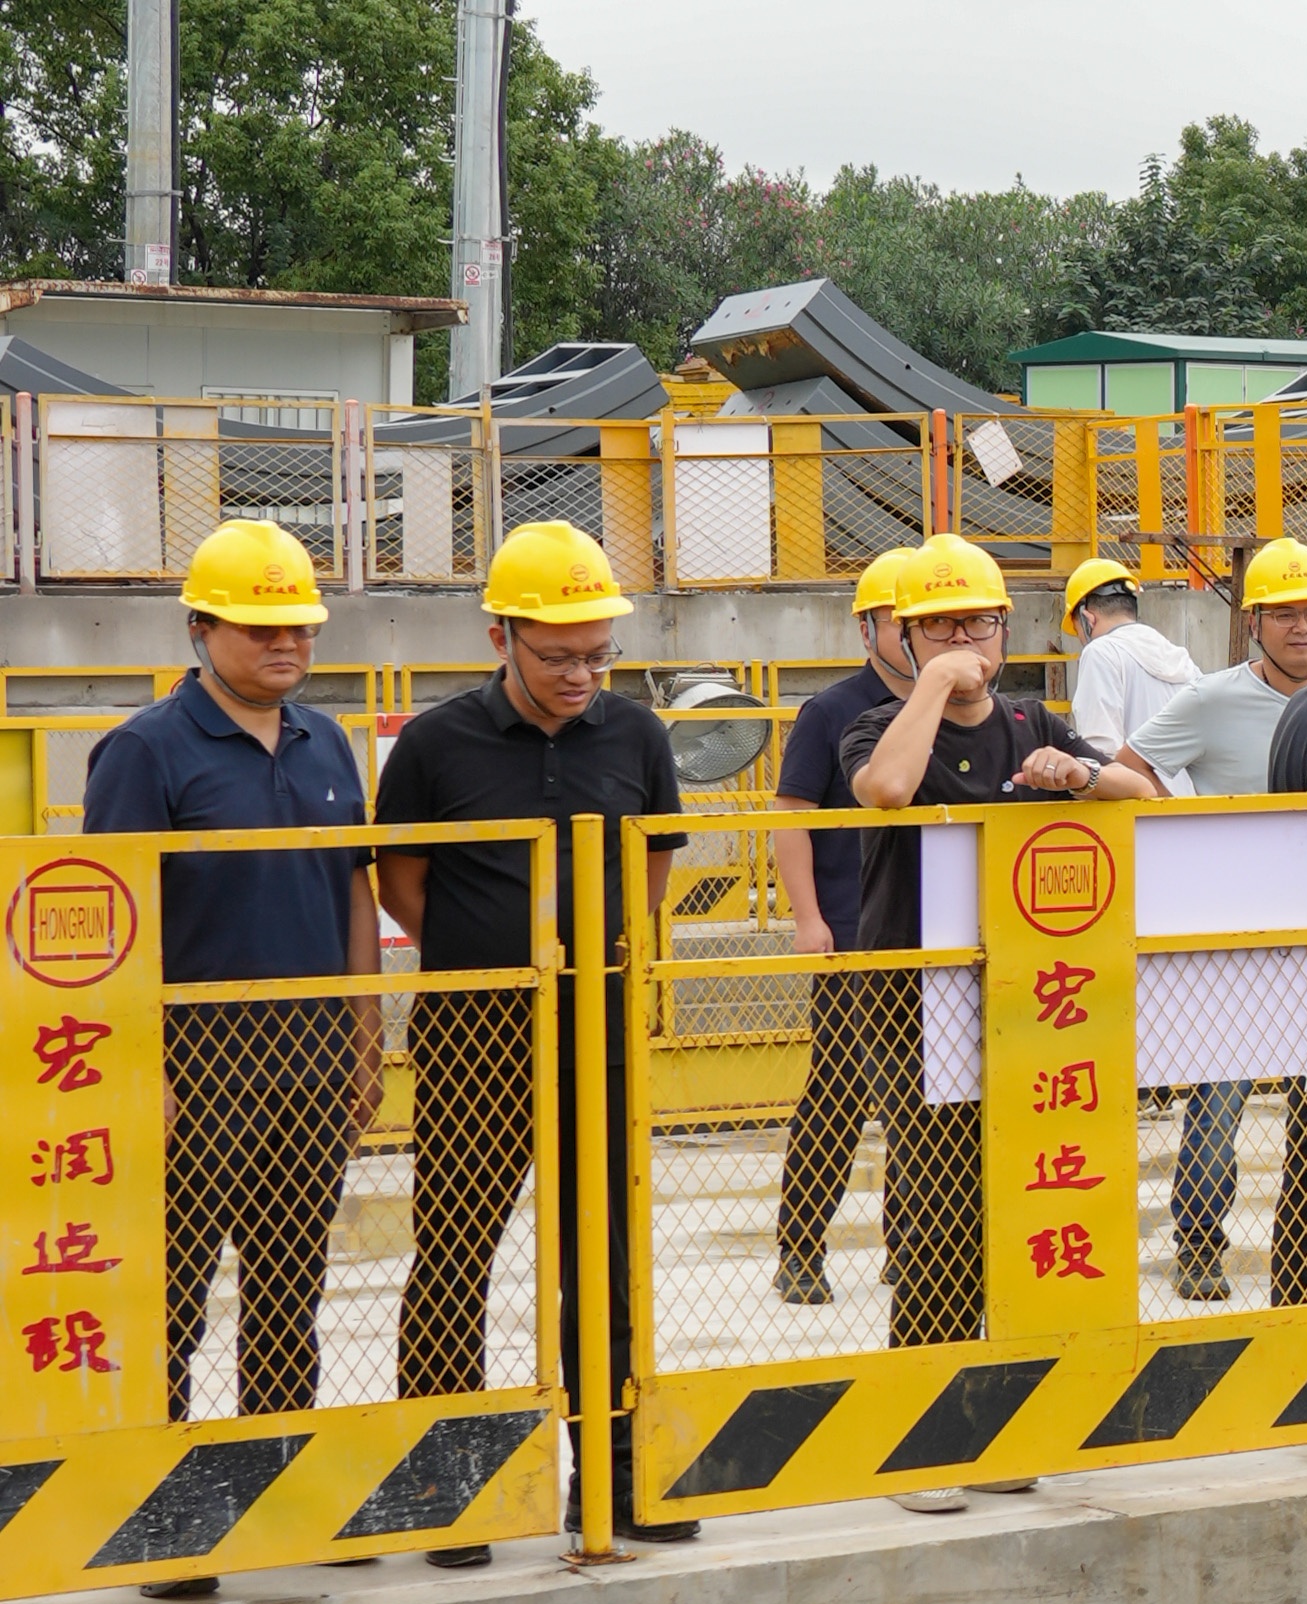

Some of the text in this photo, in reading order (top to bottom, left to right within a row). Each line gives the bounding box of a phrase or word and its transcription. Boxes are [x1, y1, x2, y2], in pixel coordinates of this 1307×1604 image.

[40, 906, 104, 941] HONGRUN
[1039, 864, 1090, 895] HONGRUN
[21, 1014, 122, 1373] 宏润建设
[1025, 960, 1105, 1279] 宏润建设
